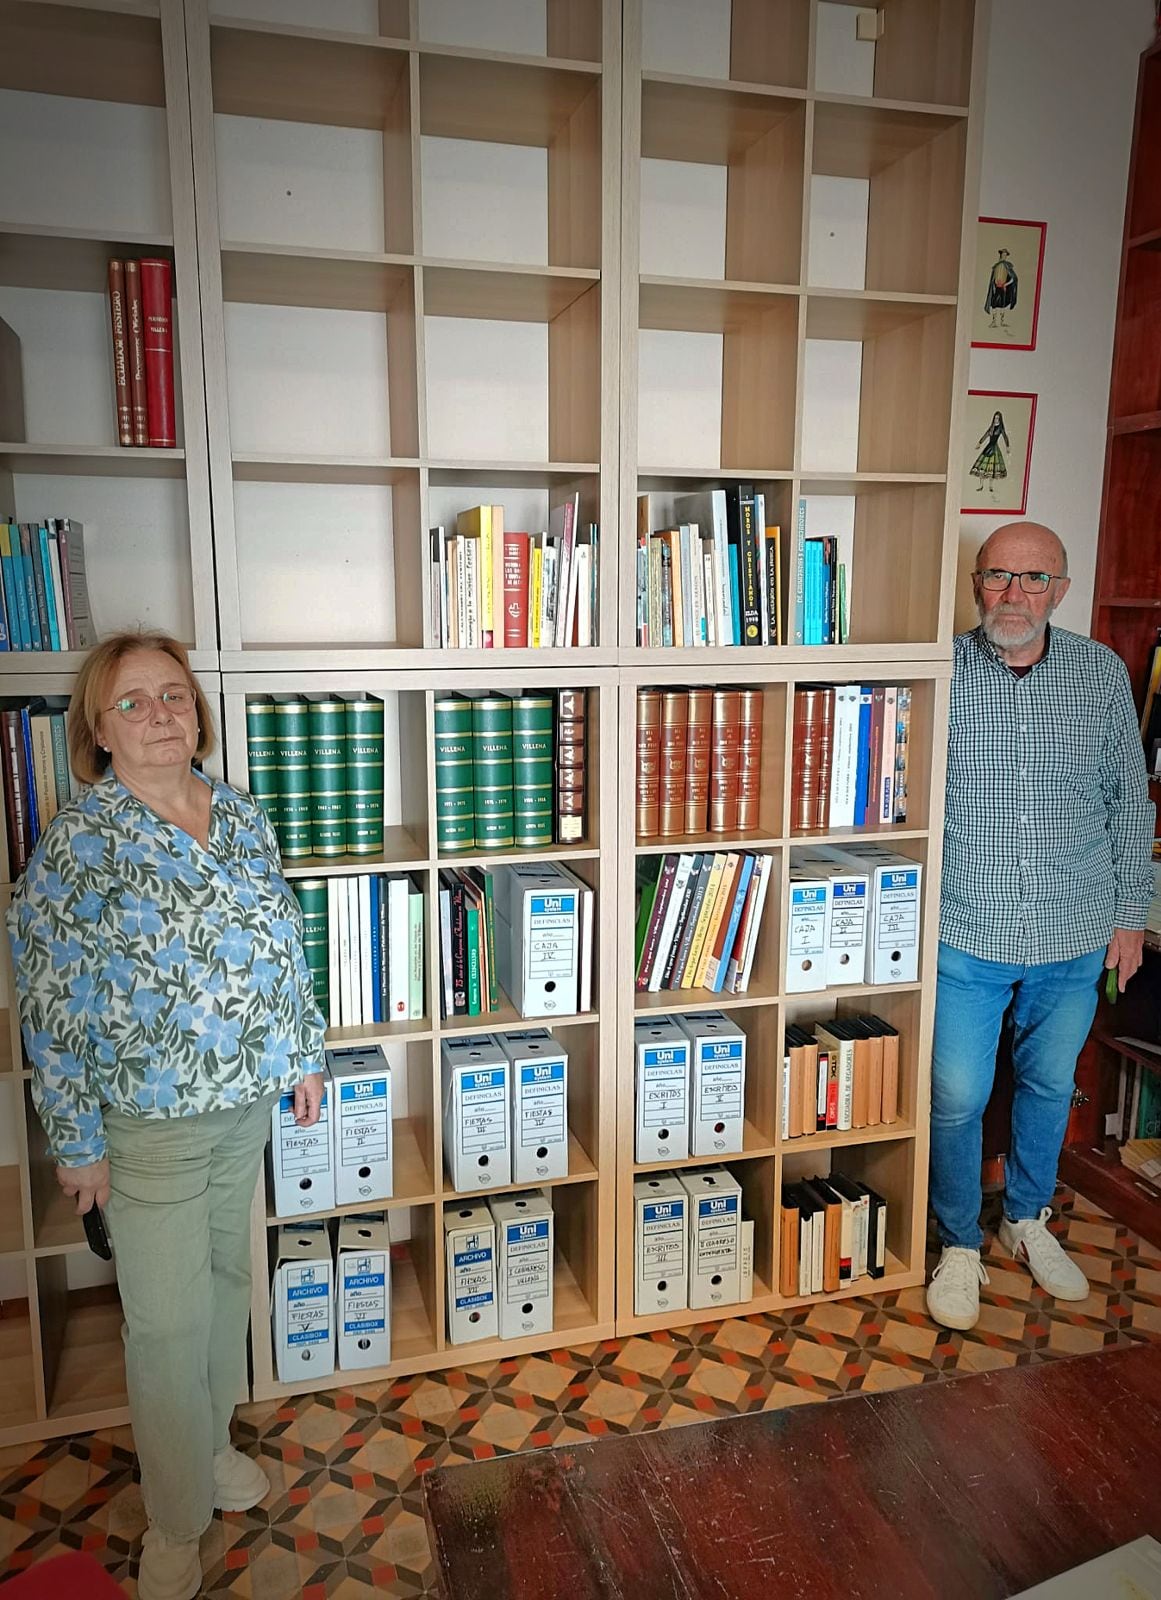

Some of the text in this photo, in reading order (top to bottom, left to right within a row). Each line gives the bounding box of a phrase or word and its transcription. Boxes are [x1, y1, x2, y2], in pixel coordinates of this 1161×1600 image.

[747, 551, 755, 607] CRISTIANOS
[884, 914, 904, 922] CAJA
[794, 925, 815, 933] CAJA
[524, 1085, 560, 1094] DEFINICLAS
[704, 1084, 738, 1093] ESCRITOS
[464, 1092, 502, 1101] DEFINICLAS
[649, 1089, 681, 1100] ESCRITOS
[345, 1103, 384, 1111] DEFINICLAS
[525, 1109, 552, 1118] FIESTAS
[464, 1118, 493, 1126] FIESTAS
[345, 1126, 377, 1136] FIESTAS
[286, 1138, 319, 1148] FIESTAS
[646, 1243, 680, 1254] ESCRITOS
[459, 1251, 487, 1262] ARCHIVO
[349, 1277, 378, 1285] ARCHIVO
[460, 1275, 487, 1286] FIESTAS
[292, 1287, 323, 1296] ARCHIVO
[347, 1300, 379, 1310] FIESTAS
[291, 1310, 324, 1321] FIESTAS
